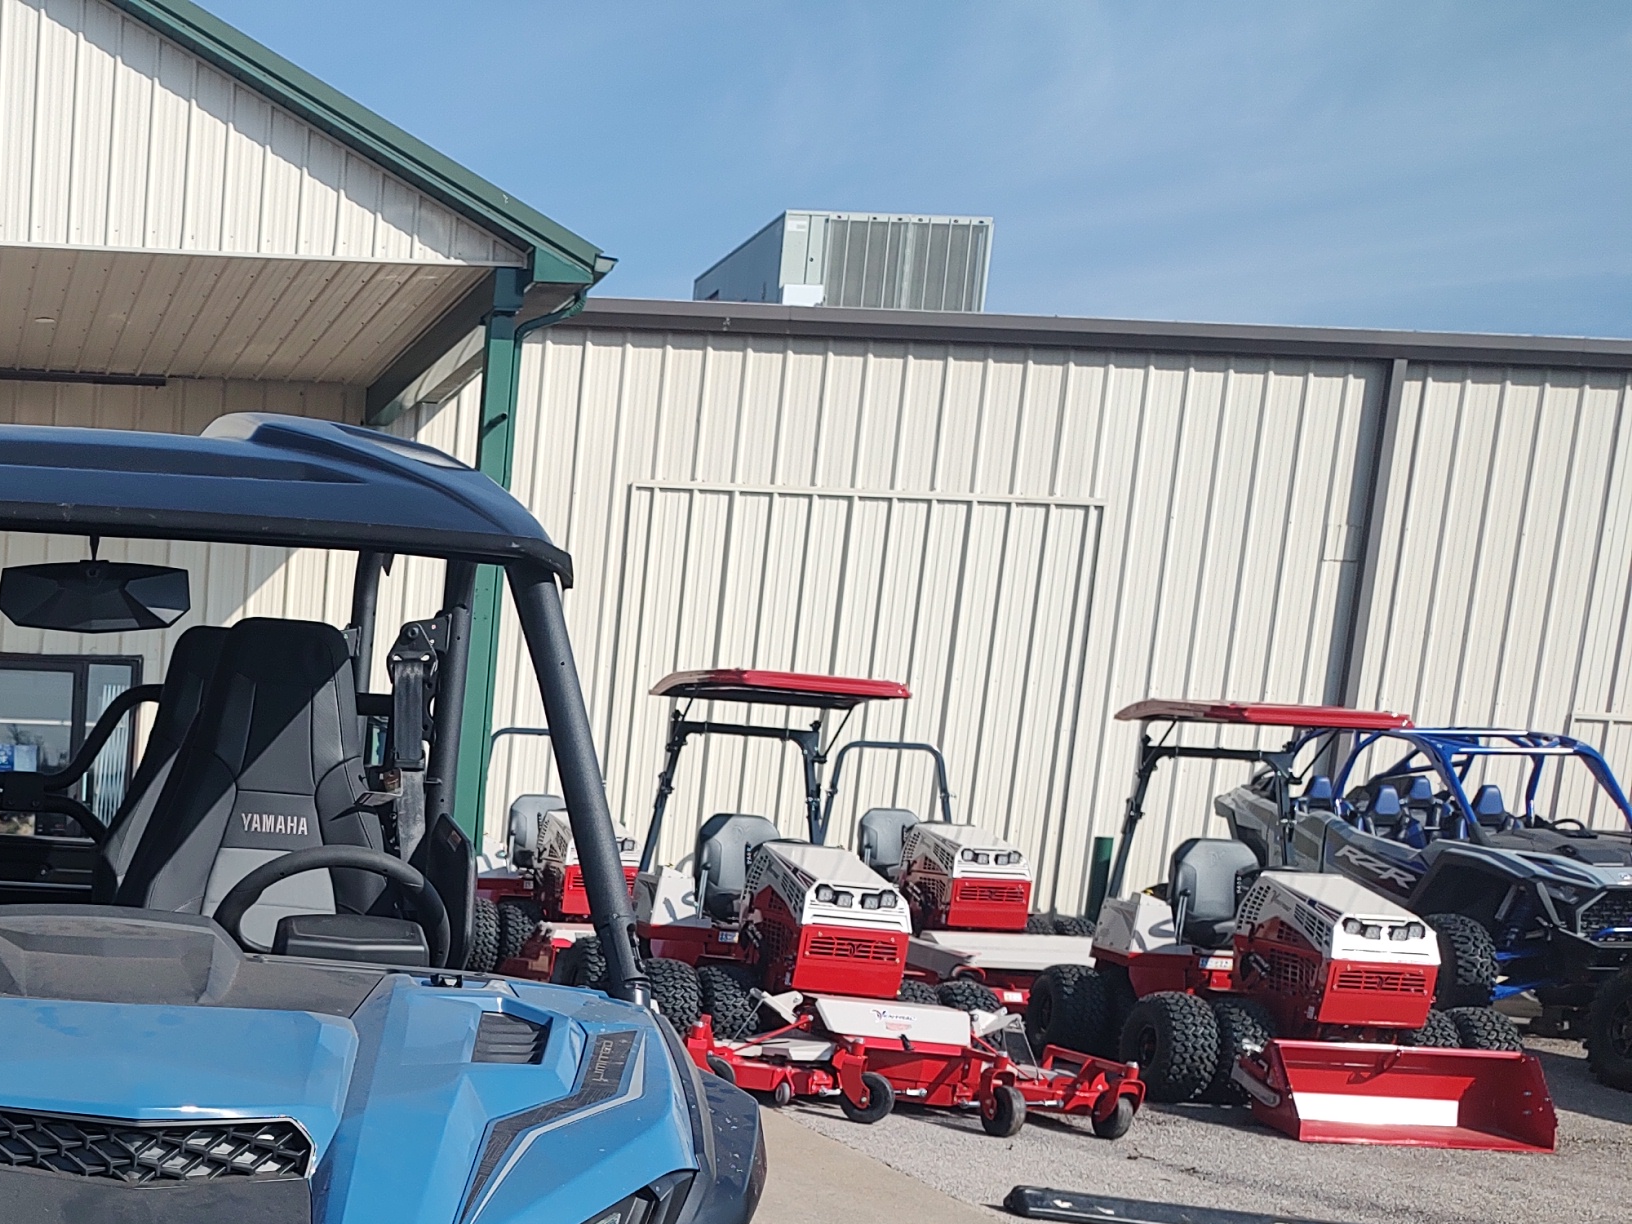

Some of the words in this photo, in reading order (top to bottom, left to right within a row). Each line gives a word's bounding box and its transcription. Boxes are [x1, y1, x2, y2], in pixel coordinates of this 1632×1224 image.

[241, 812, 308, 836] YAMAHA
[1334, 844, 1417, 890] RZR
[591, 1040, 614, 1083] LIMITED
